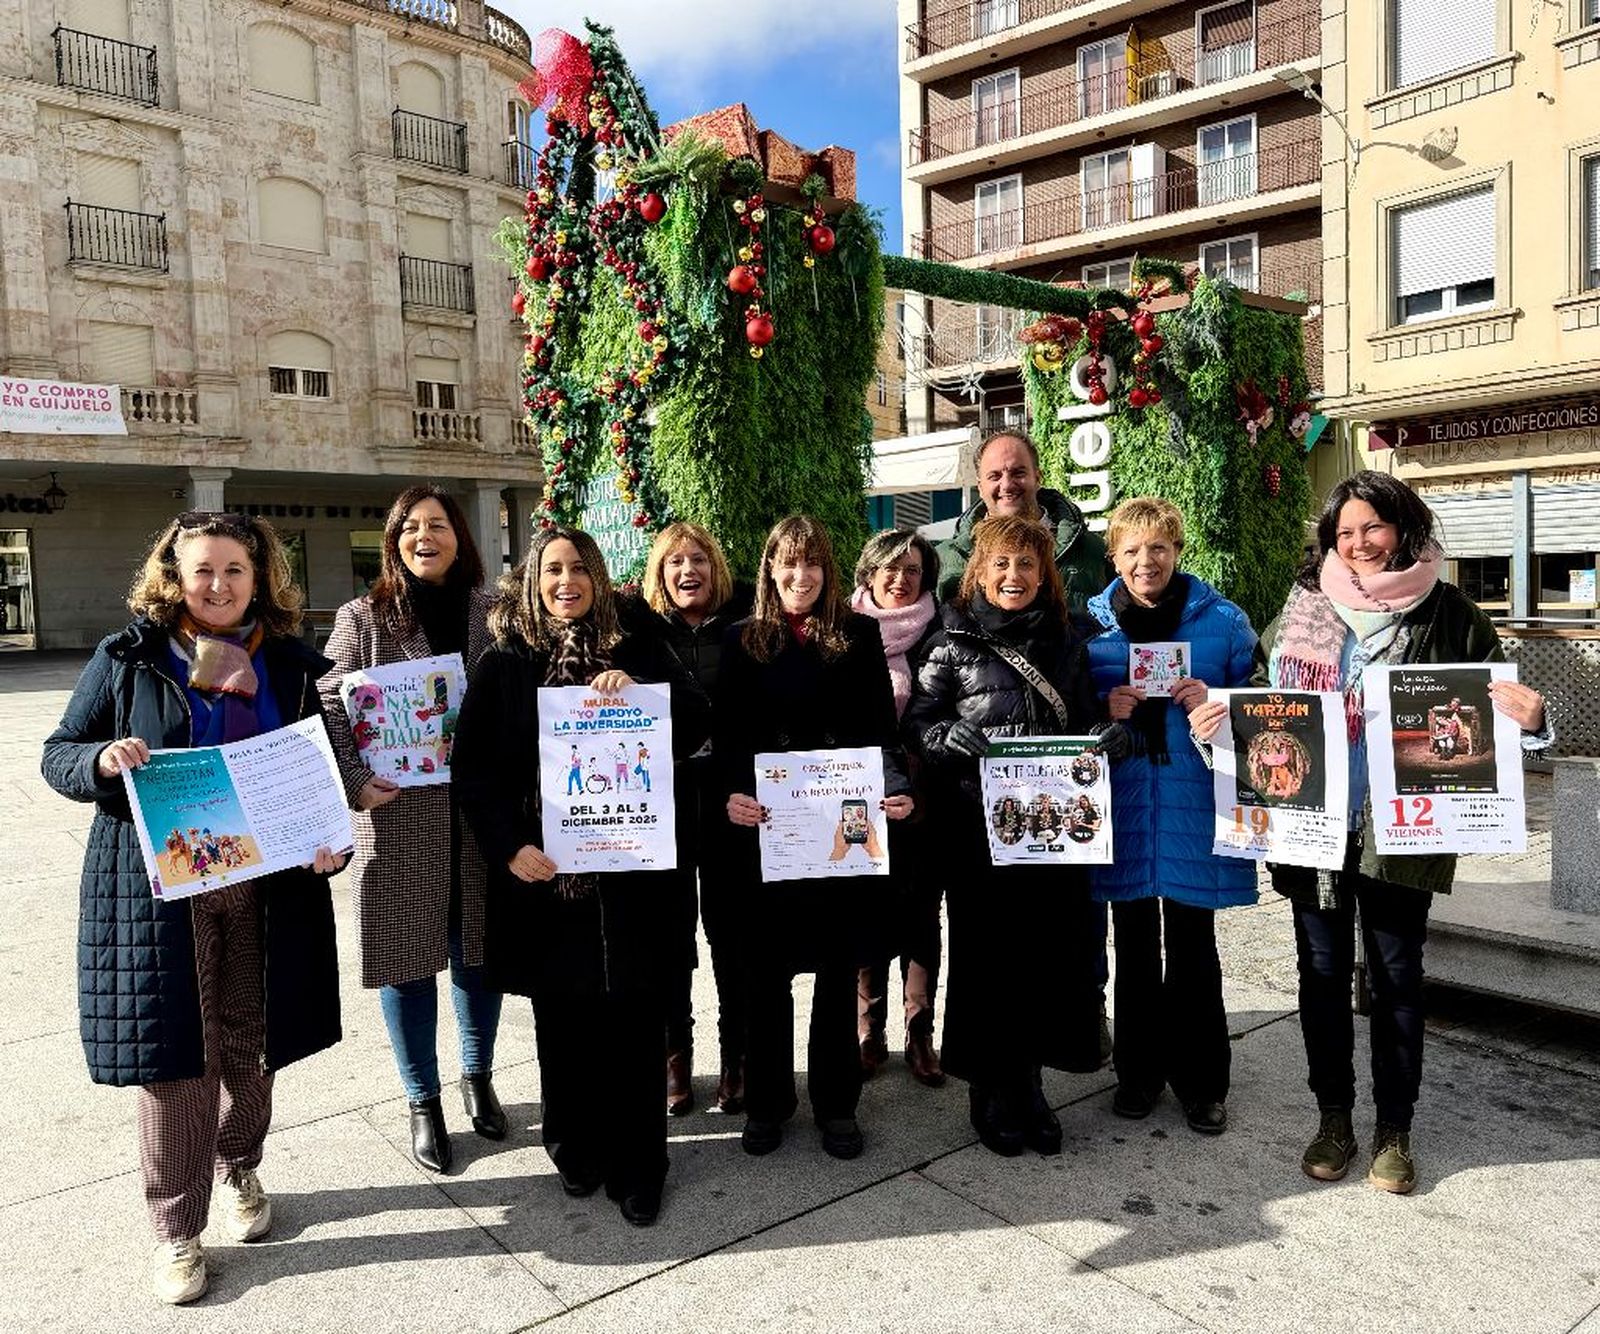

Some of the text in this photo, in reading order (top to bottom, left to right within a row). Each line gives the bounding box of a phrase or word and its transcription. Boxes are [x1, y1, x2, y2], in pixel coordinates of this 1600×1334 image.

[3, 382, 108, 399] YO COMPRO
[3, 395, 112, 412] EN GUIJUELO
[1428, 421, 1478, 440] TEJIDOS
[1482, 419, 1491, 435] Y
[1493, 405, 1598, 434] CONFECCIONES
[584, 698, 628, 708] MURAL
[1243, 701, 1309, 716] TARZÁN
[599, 707, 642, 718] APOYO
[554, 721, 571, 731] LA
[570, 802, 648, 816] DEL 3 AL 5
[1389, 796, 1434, 826] 12
[561, 815, 657, 827] DICIEMBRE 2025
[1231, 806, 1269, 835] 19
[1385, 827, 1443, 838] VIERNES
